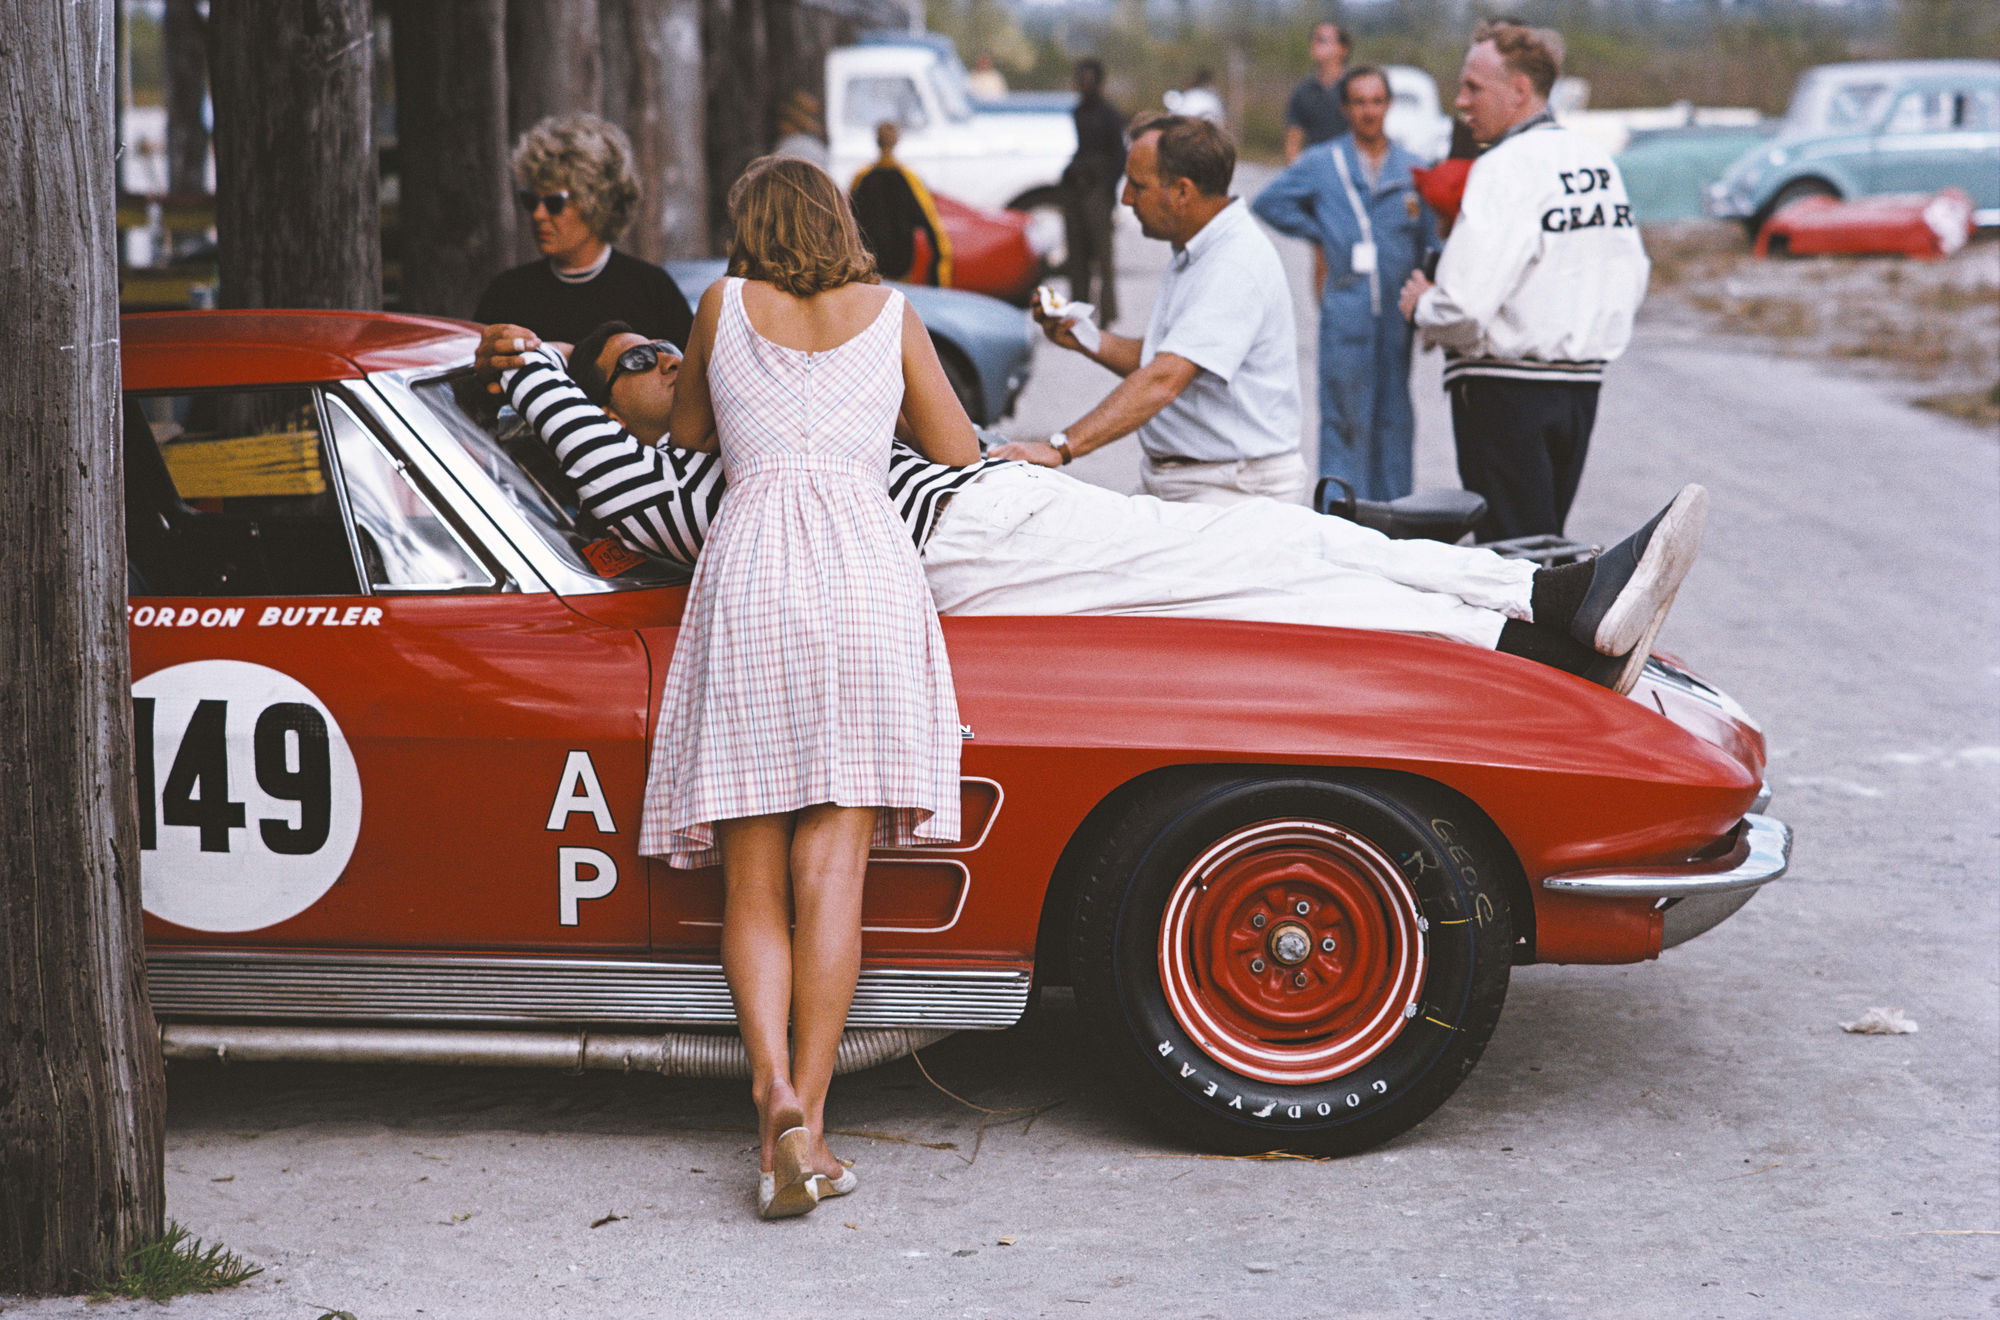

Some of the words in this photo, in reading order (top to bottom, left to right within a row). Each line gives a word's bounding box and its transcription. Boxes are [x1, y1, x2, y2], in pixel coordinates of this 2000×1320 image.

[1559, 168, 1611, 194] TOP
[1541, 203, 1633, 232] GEAR
[258, 606, 383, 626] BUTLER
[1158, 1040, 1388, 1119] GOODYEAR
